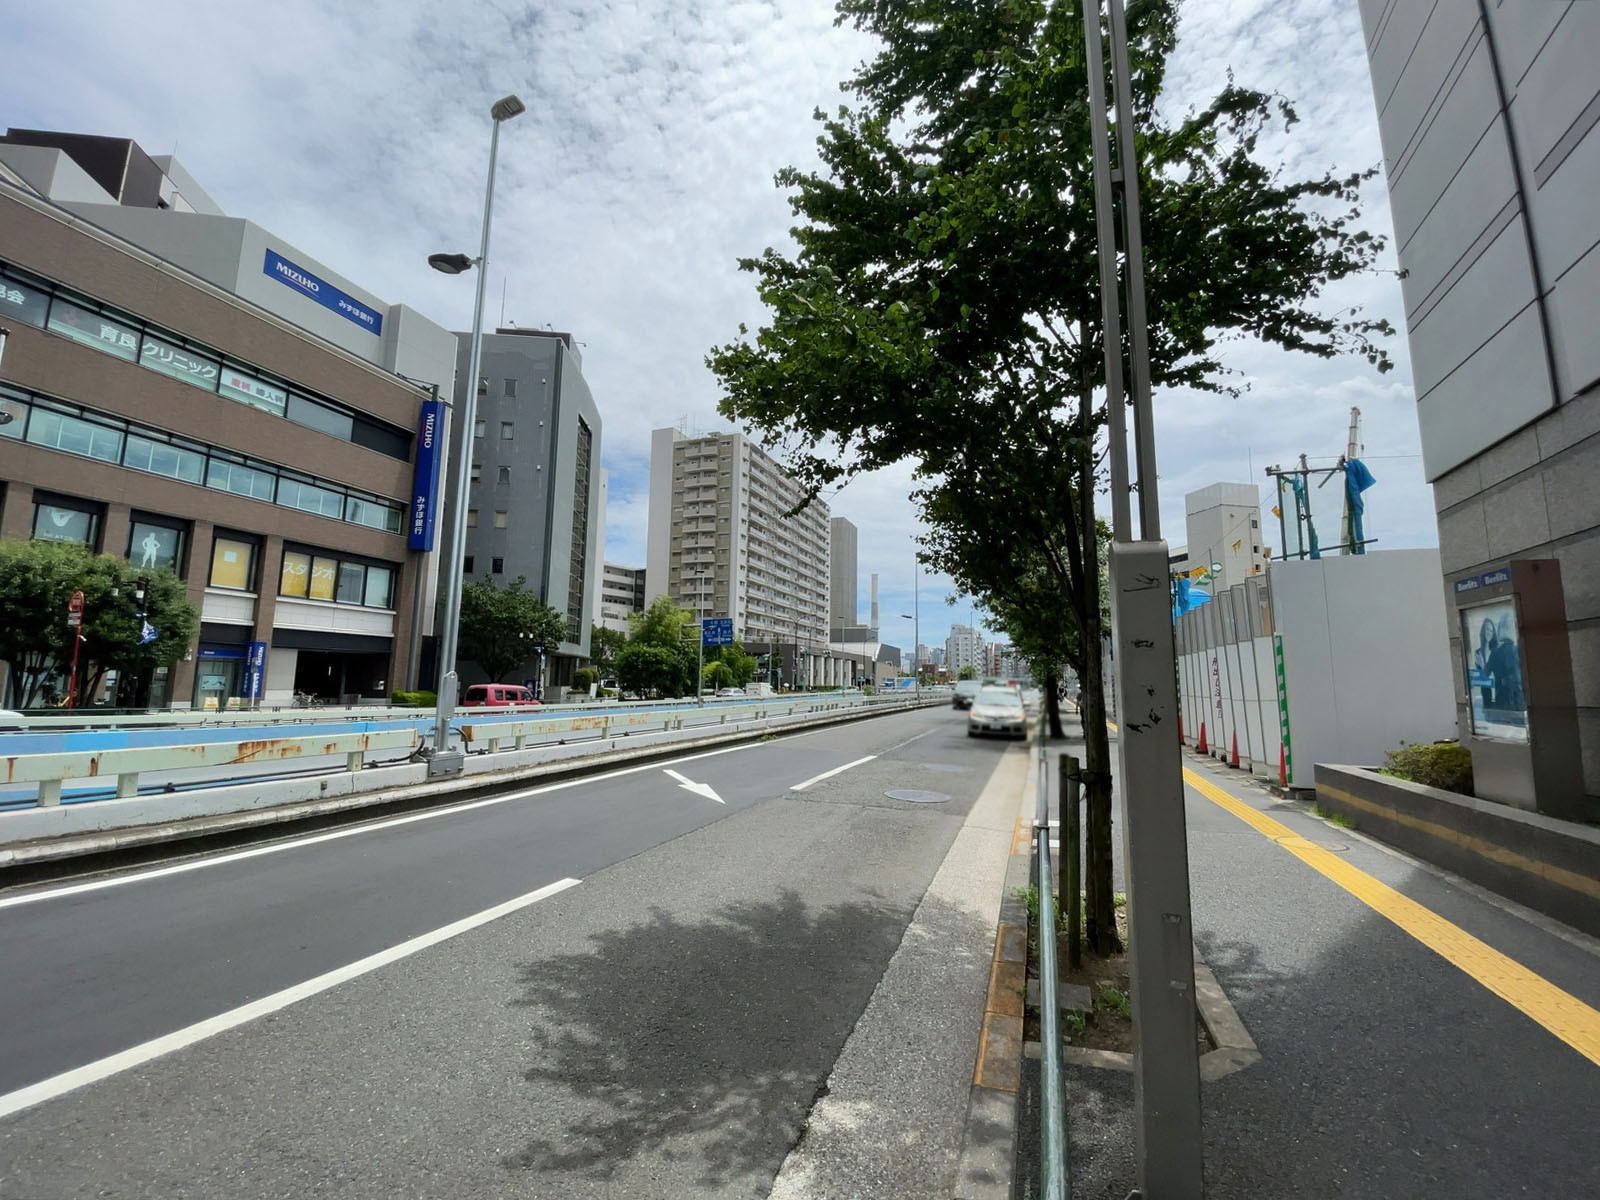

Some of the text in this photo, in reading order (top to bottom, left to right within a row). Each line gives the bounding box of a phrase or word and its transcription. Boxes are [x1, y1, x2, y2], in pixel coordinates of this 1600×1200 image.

[276, 262, 320, 292] MIZUHO
[338, 300, 374, 325] みずほ銀行
[423, 413, 435, 449] MIZUHO
[414, 496, 425, 535] みずほ銀行
